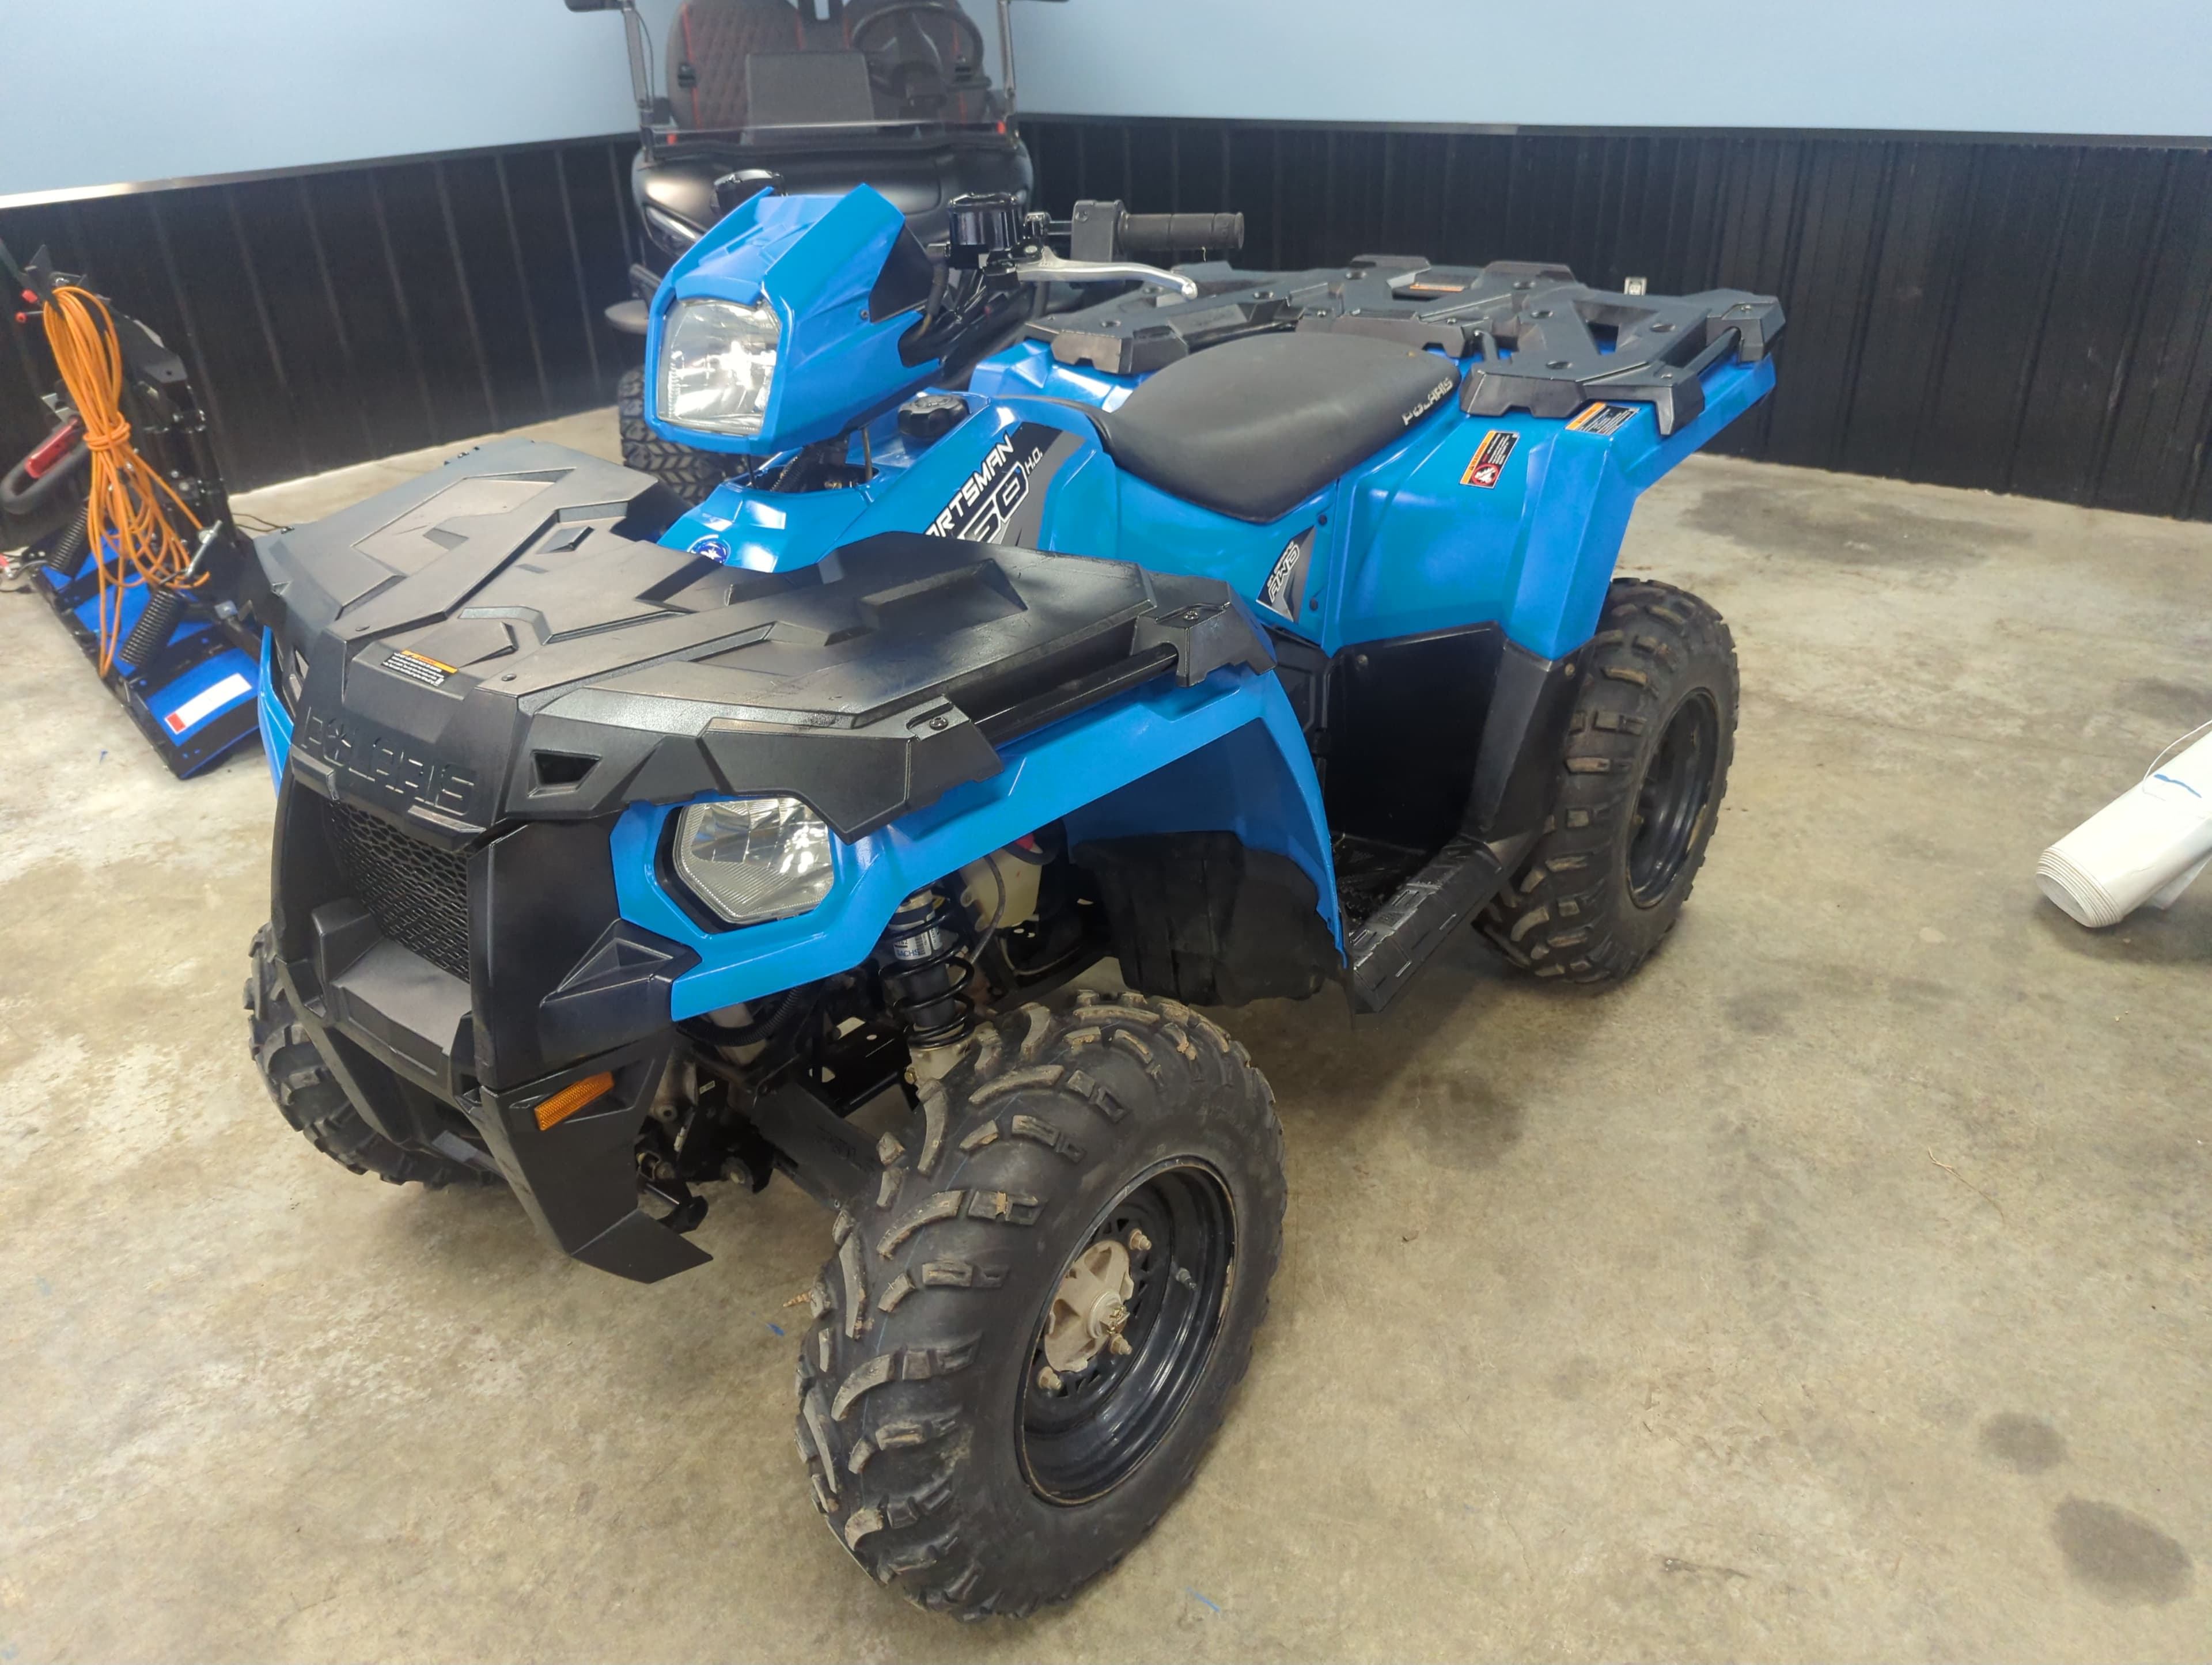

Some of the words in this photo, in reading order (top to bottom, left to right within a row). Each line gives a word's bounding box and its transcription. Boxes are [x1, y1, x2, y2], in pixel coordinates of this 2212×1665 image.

[1401, 377, 1453, 426] POLARIS
[925, 434, 1014, 537] RTSMAN
[957, 461, 1029, 543] 50
[1024, 447, 1043, 475] H.O.
[1268, 544, 1300, 603] AWD
[300, 706, 477, 816] POLARIS
